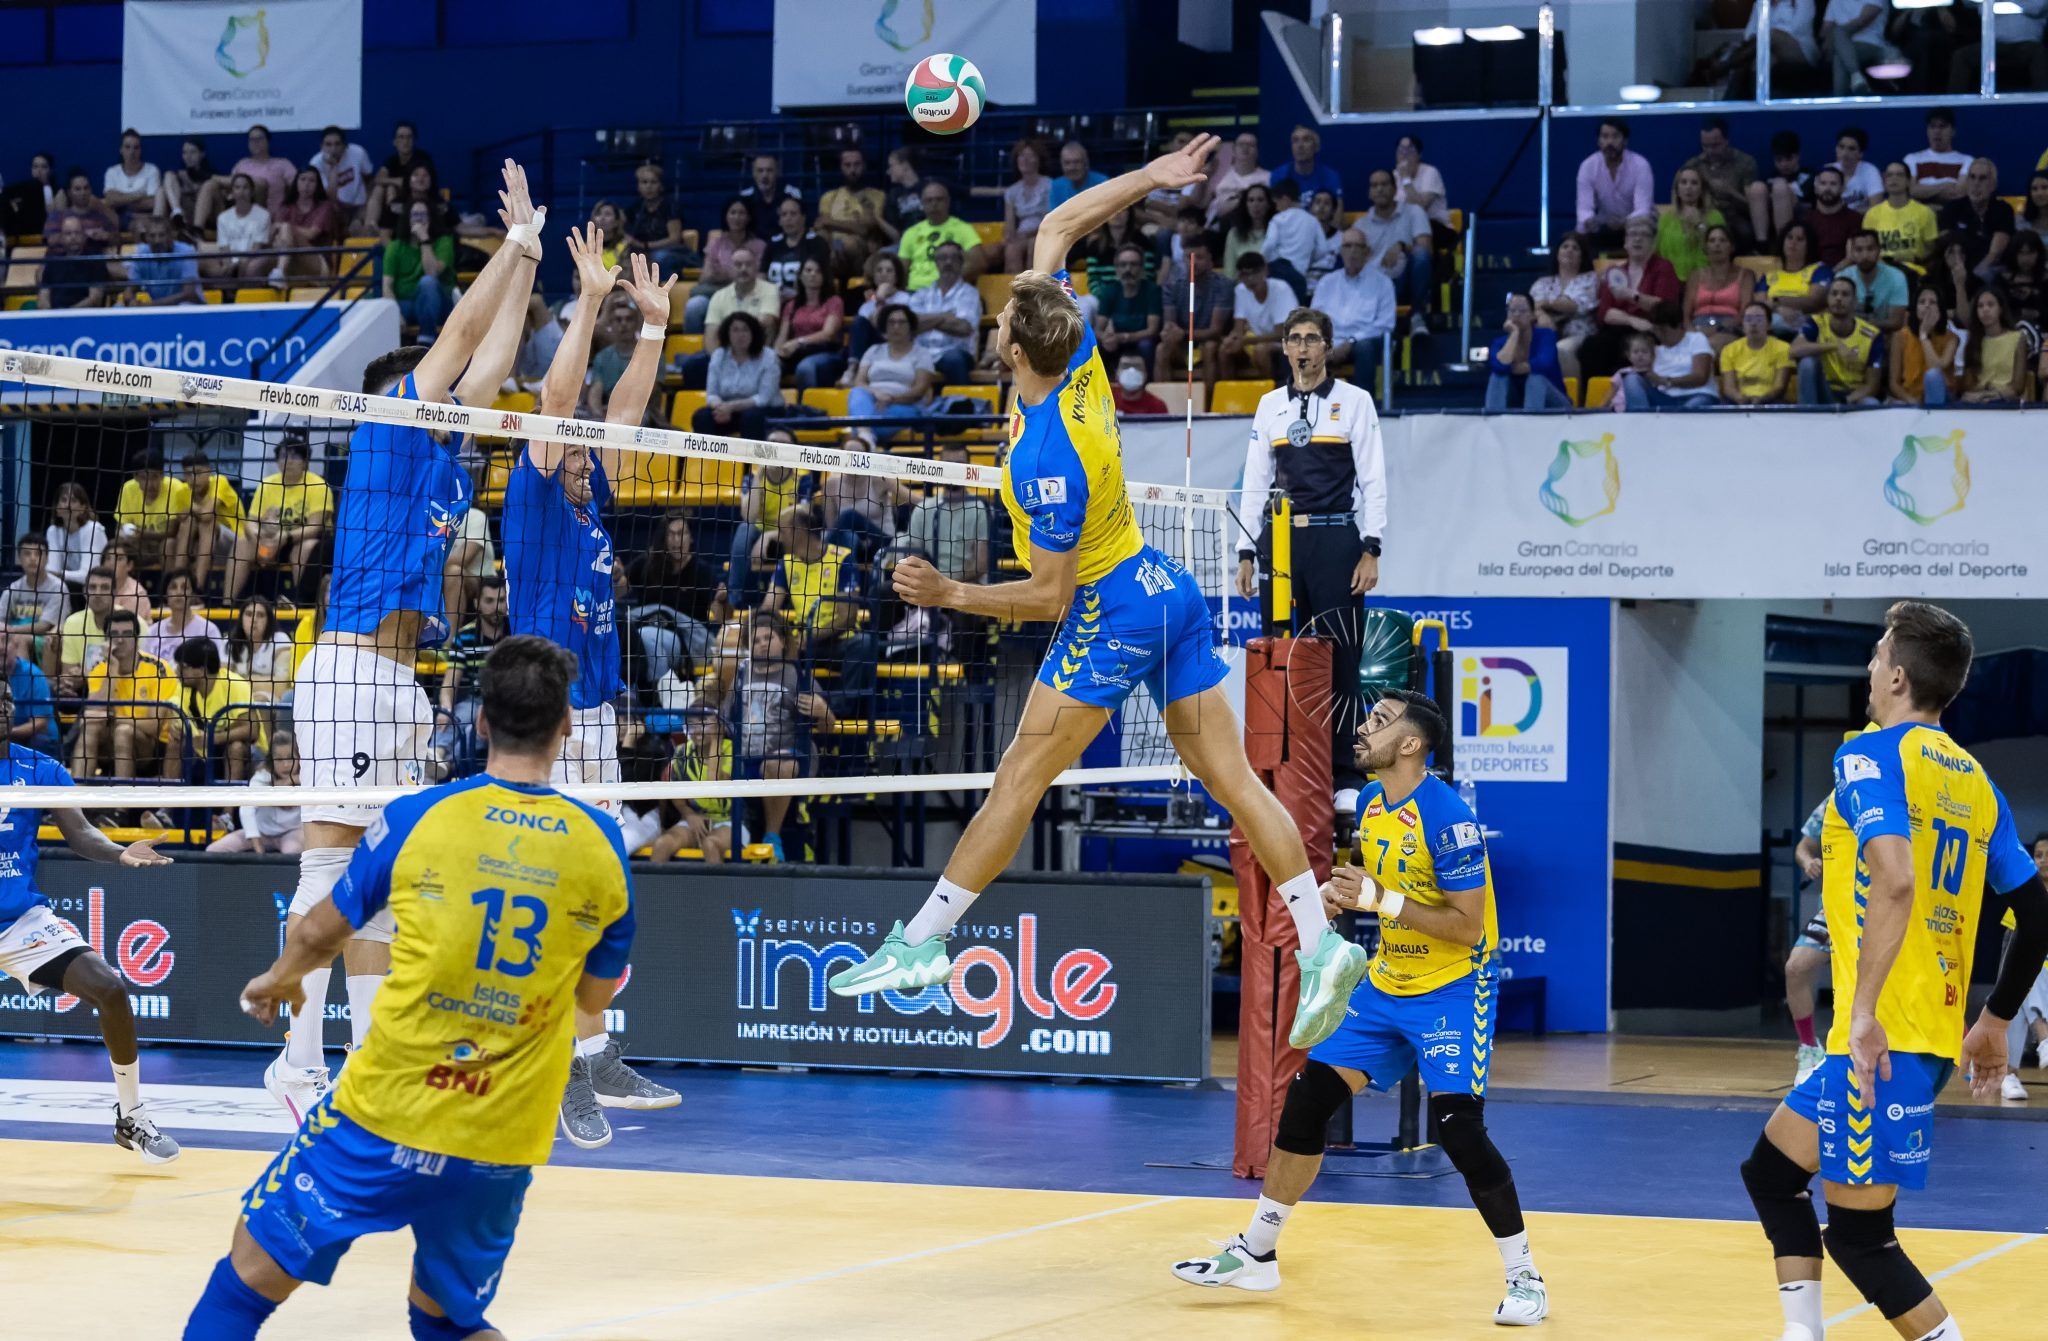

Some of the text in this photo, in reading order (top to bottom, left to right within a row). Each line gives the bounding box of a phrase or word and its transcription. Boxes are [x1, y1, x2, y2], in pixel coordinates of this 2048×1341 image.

[918, 107, 951, 117] molten
[85, 364, 152, 389] rfevb.com
[259, 385, 319, 408] rfevb.com
[416, 405, 470, 426] rfevb.com
[556, 421, 605, 440] rfevb.com
[684, 437, 728, 454] rfevb.com
[799, 447, 840, 467] rfevb.com
[905, 460, 943, 477] rfevb.com
[1478, 562, 1674, 580] Isla Europea del Deporte
[1824, 561, 2028, 579] Isla Europea del Deporte
[1453, 742, 1505, 755] NSTITUTO
[1921, 744, 1975, 774] ALMANSA
[351, 751, 371, 779] 9
[1471, 757, 1549, 773] DEPORTES
[484, 805, 569, 835] ZONCA
[1399, 810, 1416, 826] Pinay
[1377, 838, 1390, 876] 7
[1931, 817, 1969, 896] 10
[471, 887, 549, 978] 13
[764, 918, 877, 936] servicios
[427, 991, 518, 1026] Canarias
[473, 981, 521, 1009] Islas
[737, 1020, 974, 1047] IMPRESIÓN Y ROTULACIÓN
[1020, 1028, 1112, 1056] .com
[1422, 1044, 1461, 1060] HPS
